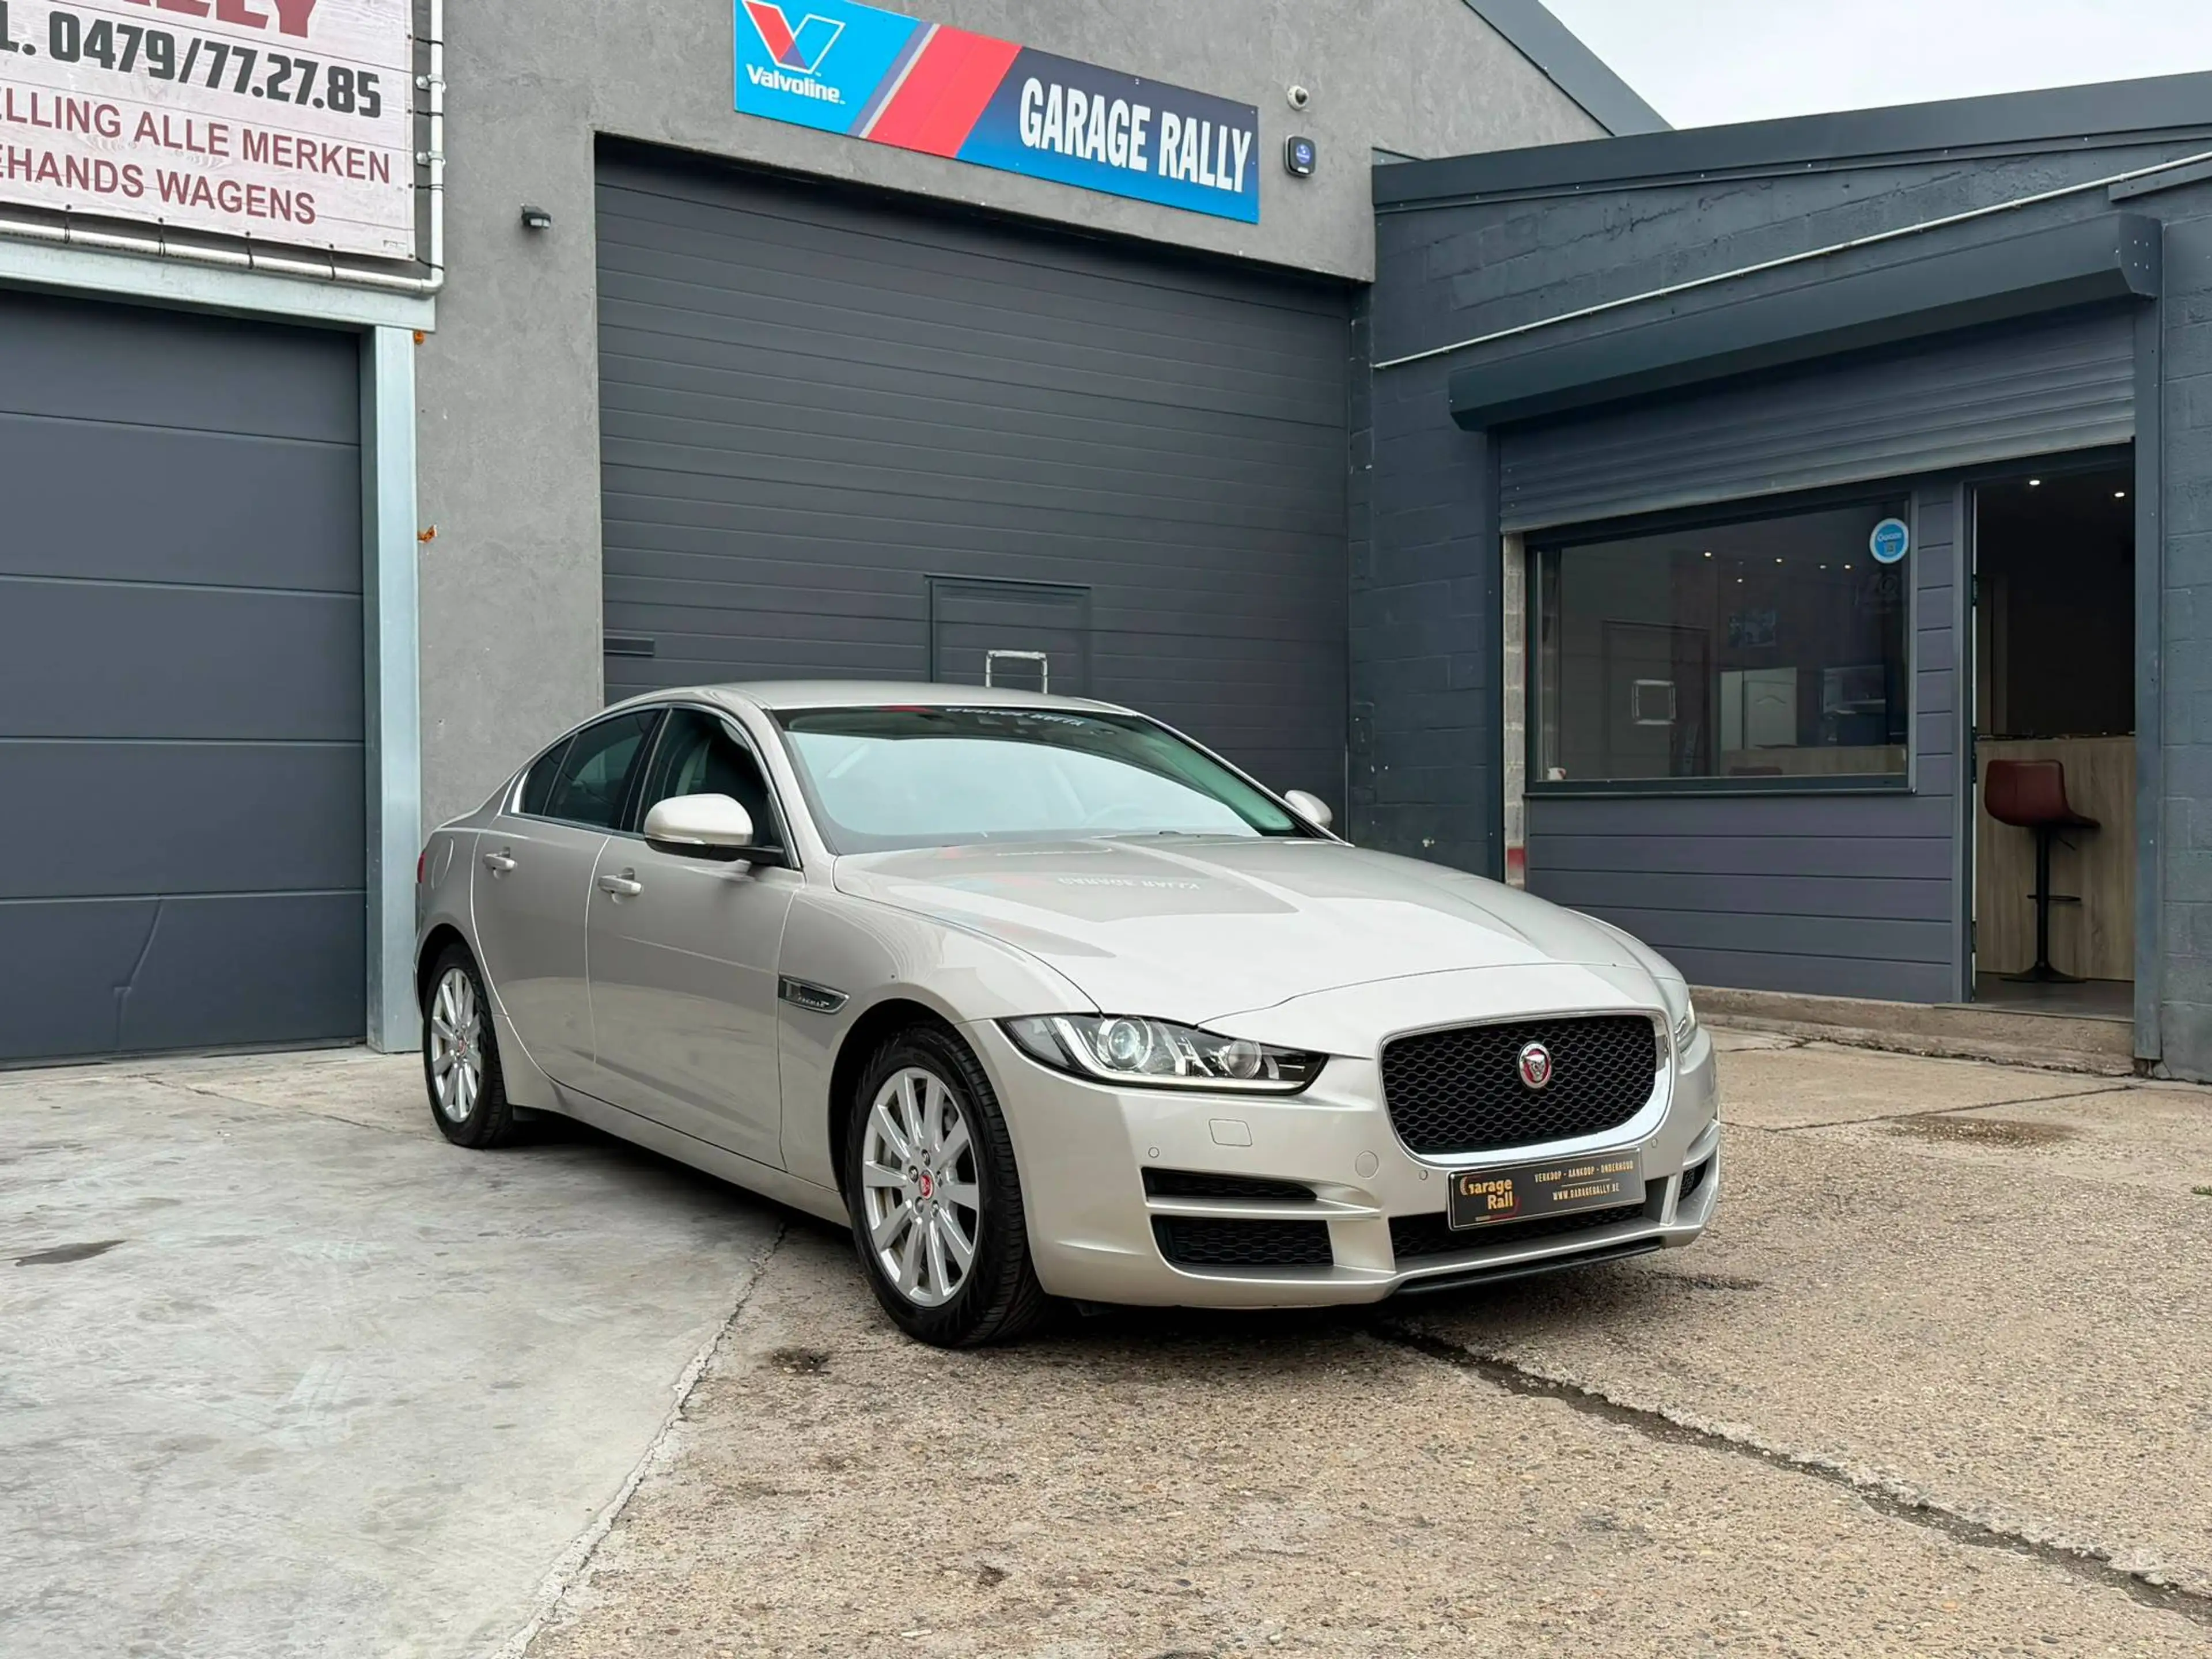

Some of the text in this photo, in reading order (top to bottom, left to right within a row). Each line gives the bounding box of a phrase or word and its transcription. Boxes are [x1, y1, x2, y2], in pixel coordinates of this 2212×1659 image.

[50, 11, 381, 118] 0479/77.27.85
[746, 63, 841, 104] Valvoline
[0, 88, 390, 184] LLING ALLE MERKEN
[1020, 77, 1252, 192] GARAGE RALLY
[0, 145, 316, 224] HANDS WAGENS
[1535, 1171, 1562, 1183] VERKOOP
[1568, 1166, 1594, 1178] AANKOOP
